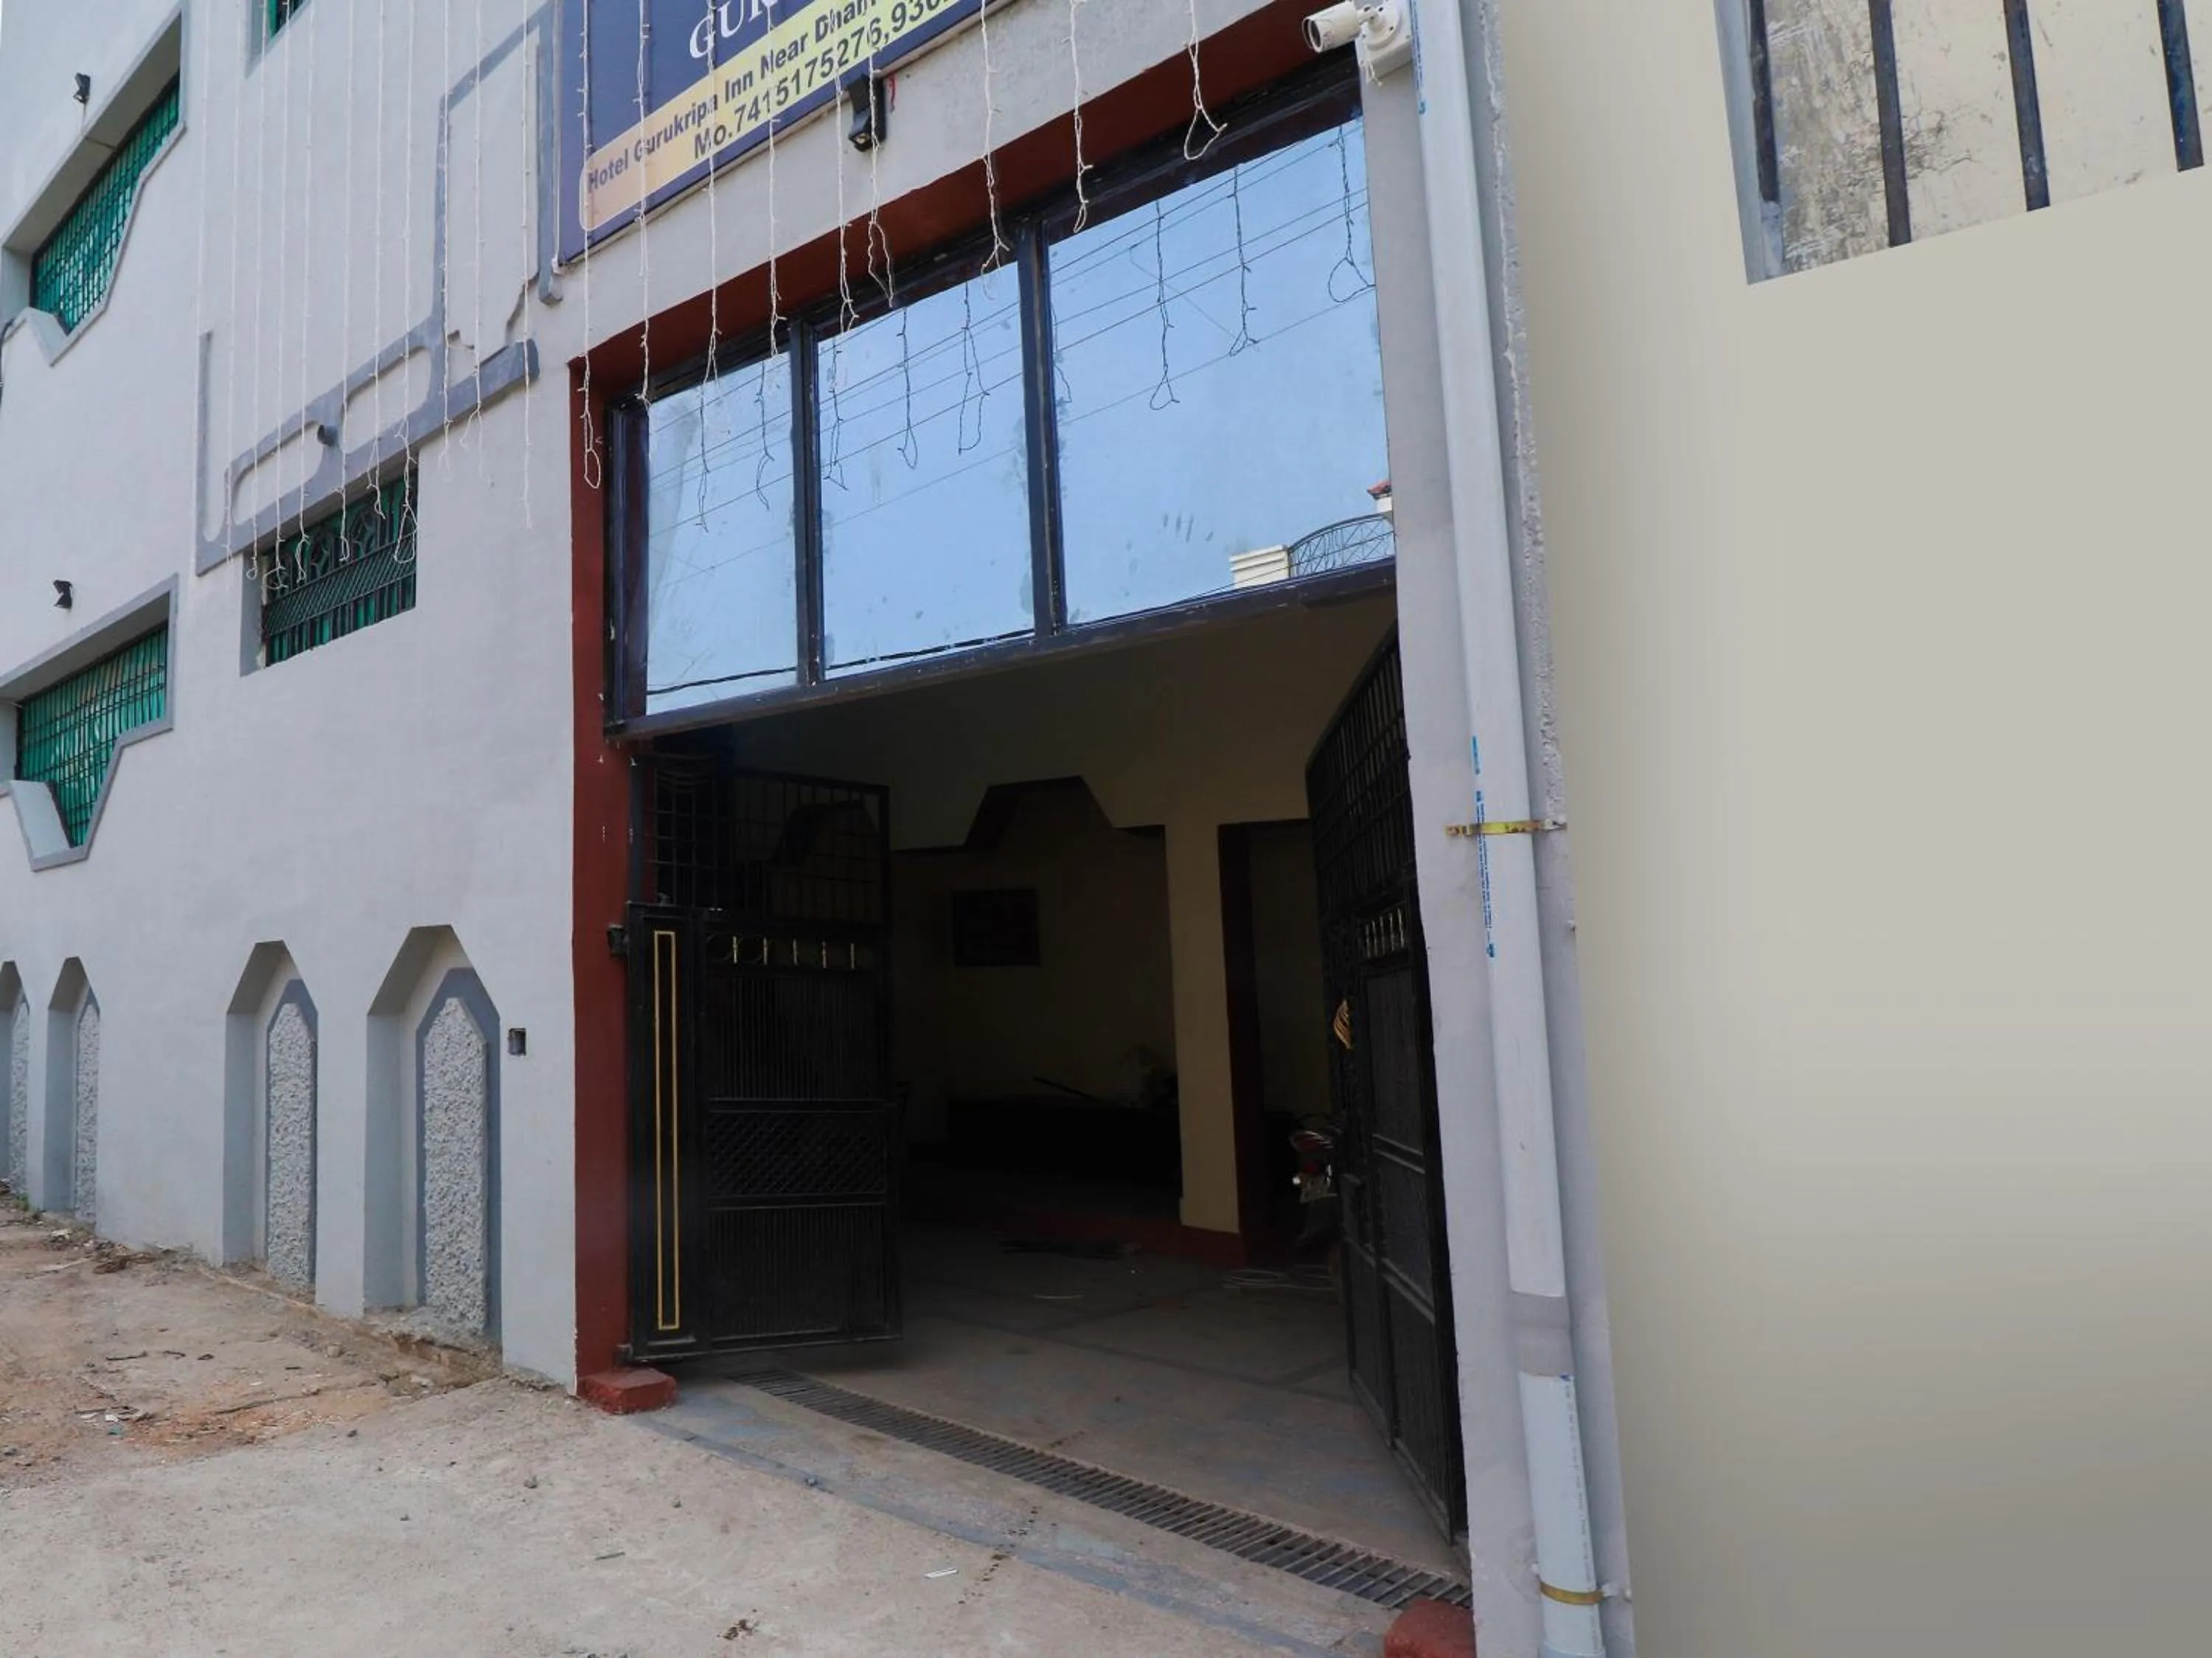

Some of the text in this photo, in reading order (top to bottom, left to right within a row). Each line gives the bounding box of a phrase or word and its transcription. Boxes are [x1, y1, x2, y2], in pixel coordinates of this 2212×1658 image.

[587, 148, 628, 192] Hotel
[633, 94, 718, 162] Gurukripa
[725, 70, 754, 103] Inn
[760, 32, 809, 80] Near
[695, 0, 949, 159] Mo.7415175276,93
